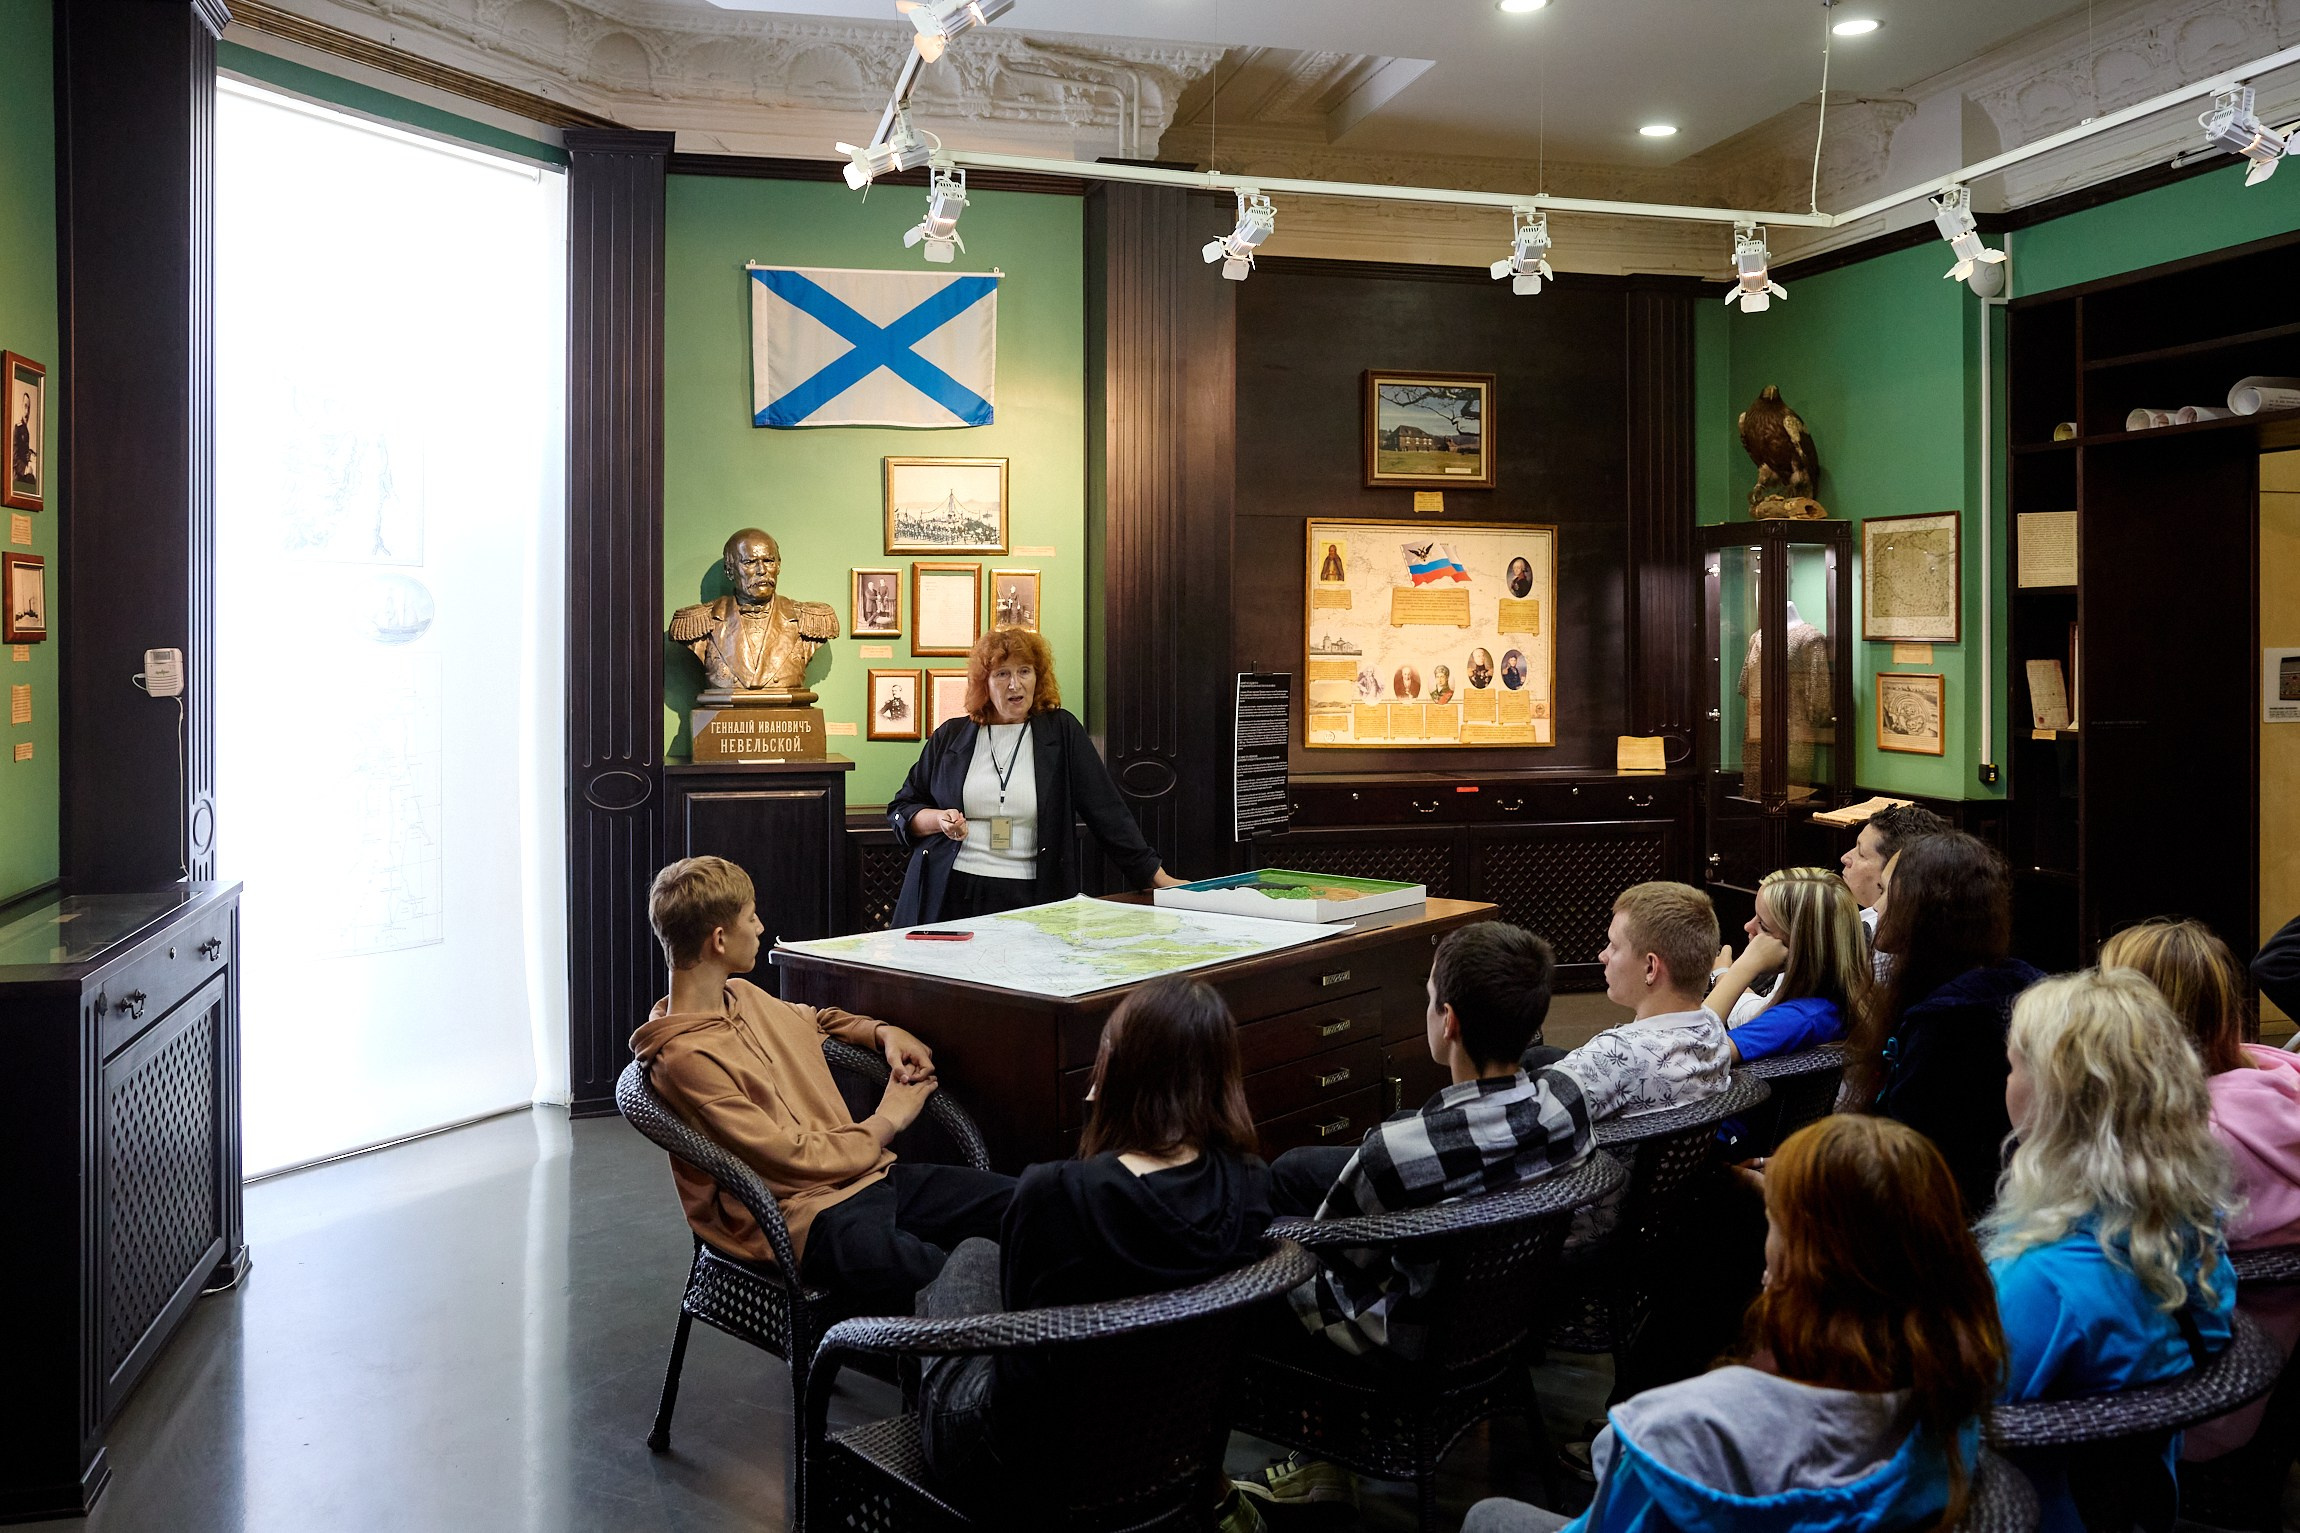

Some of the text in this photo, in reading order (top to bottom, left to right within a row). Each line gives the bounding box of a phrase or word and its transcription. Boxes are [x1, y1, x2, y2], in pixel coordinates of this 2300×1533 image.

[711, 720, 755, 734] ГЕННАДІЙ
[758, 720, 812, 733] ИВАНОВИЧЪ
[720, 735, 804, 753] НЕВЕЛЬСКОЙ.
